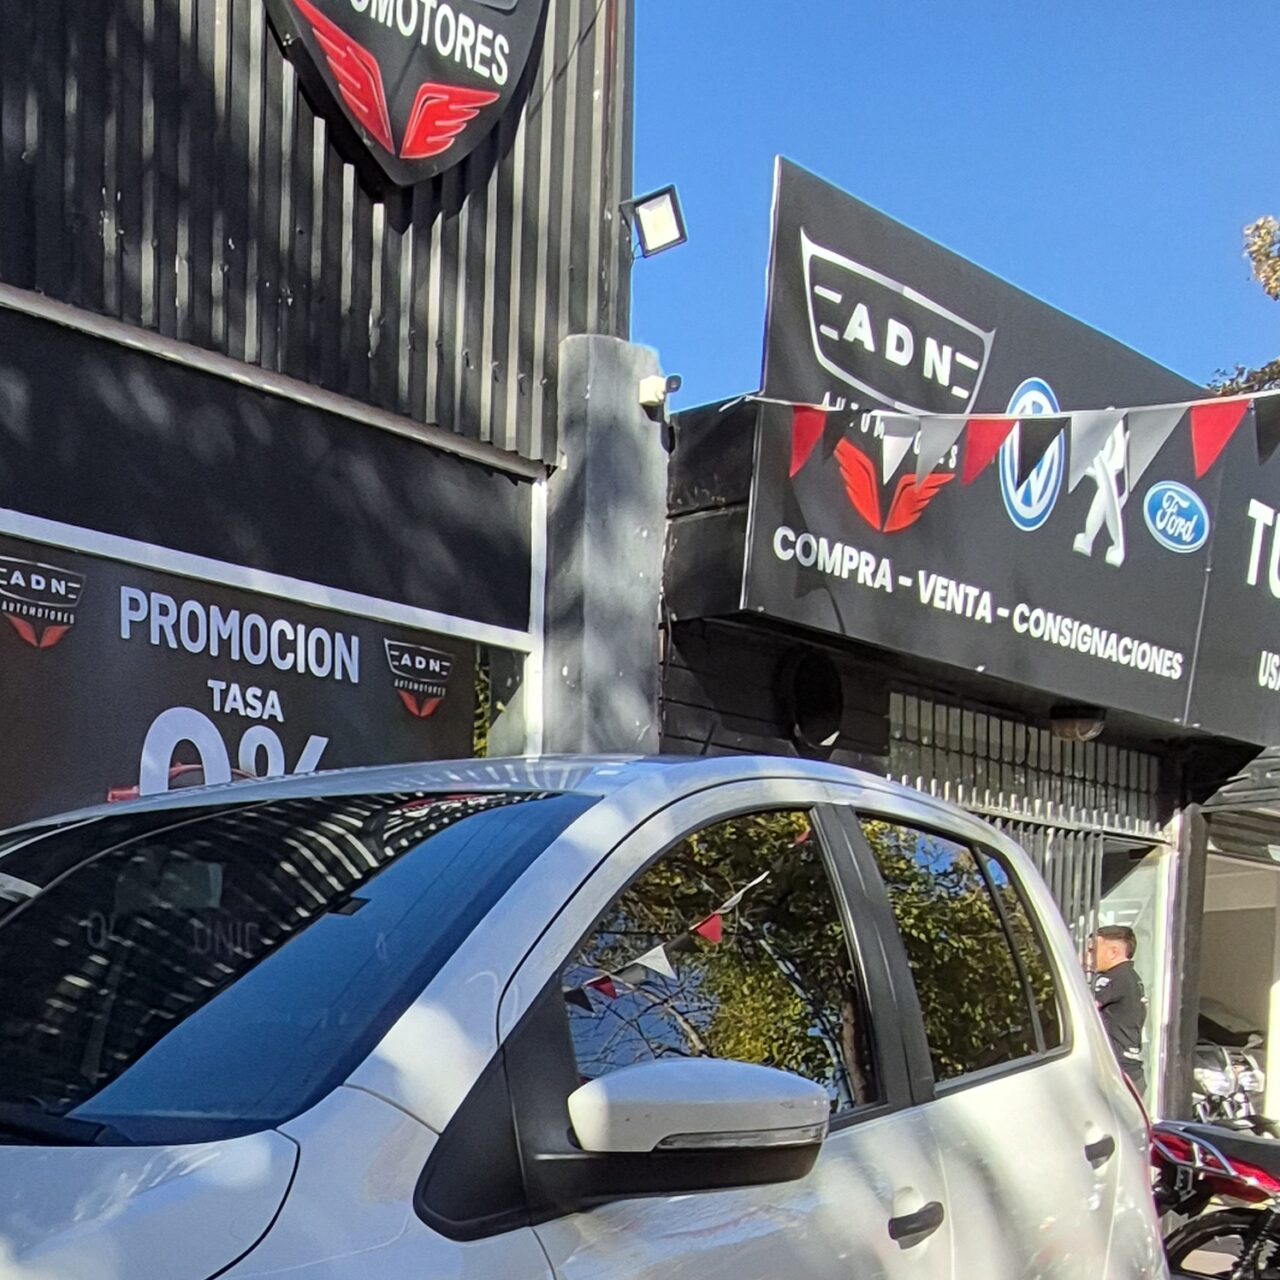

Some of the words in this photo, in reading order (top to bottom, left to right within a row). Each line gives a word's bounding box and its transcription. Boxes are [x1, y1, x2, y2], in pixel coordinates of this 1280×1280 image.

[1156, 491, 1199, 543] Ford
[120, 585, 359, 684] PROMOCION
[773, 526, 893, 593] COMPRA
[919, 570, 992, 624] VENTA
[1012, 603, 1185, 681] CONSIGNACIONES
[207, 678, 286, 722] TASA
